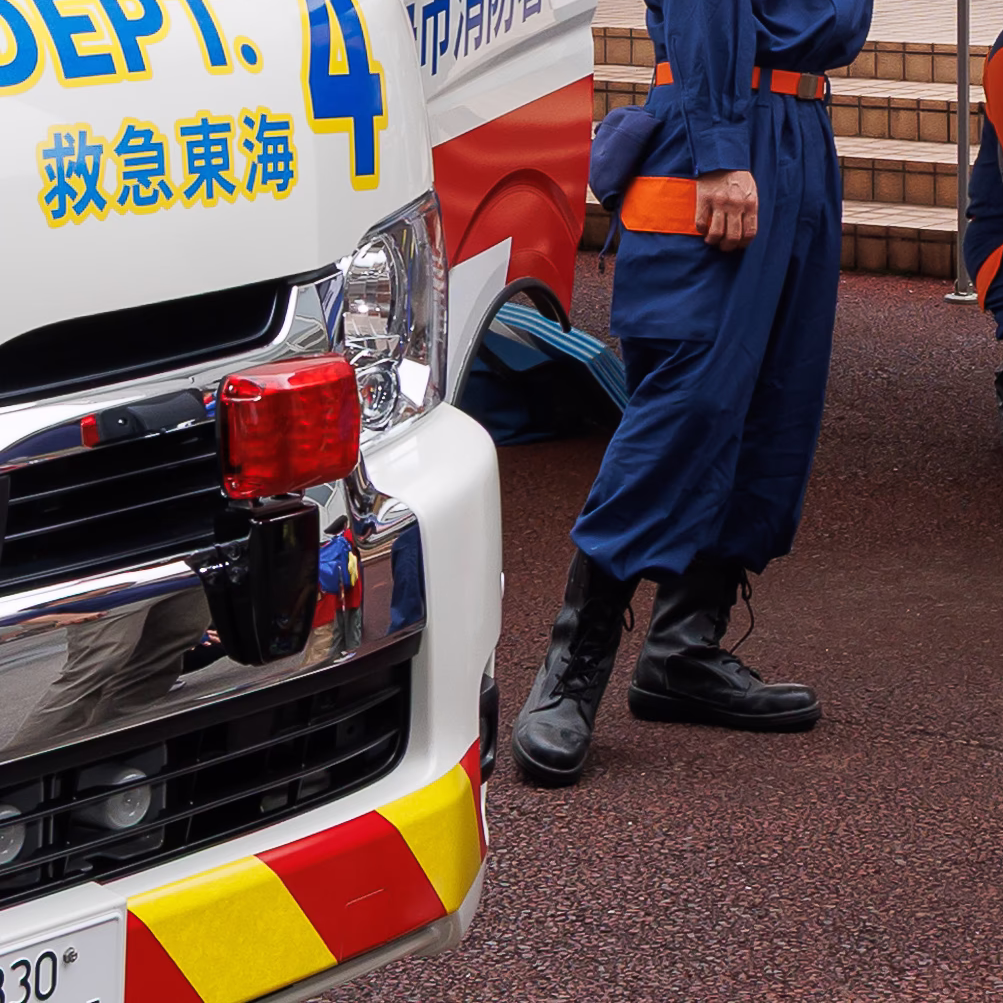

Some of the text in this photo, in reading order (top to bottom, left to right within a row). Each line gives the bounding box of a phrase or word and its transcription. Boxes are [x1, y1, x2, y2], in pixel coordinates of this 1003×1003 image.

[39, 108, 297, 225] 救急東海
[0, 950, 58, 1003] 30
